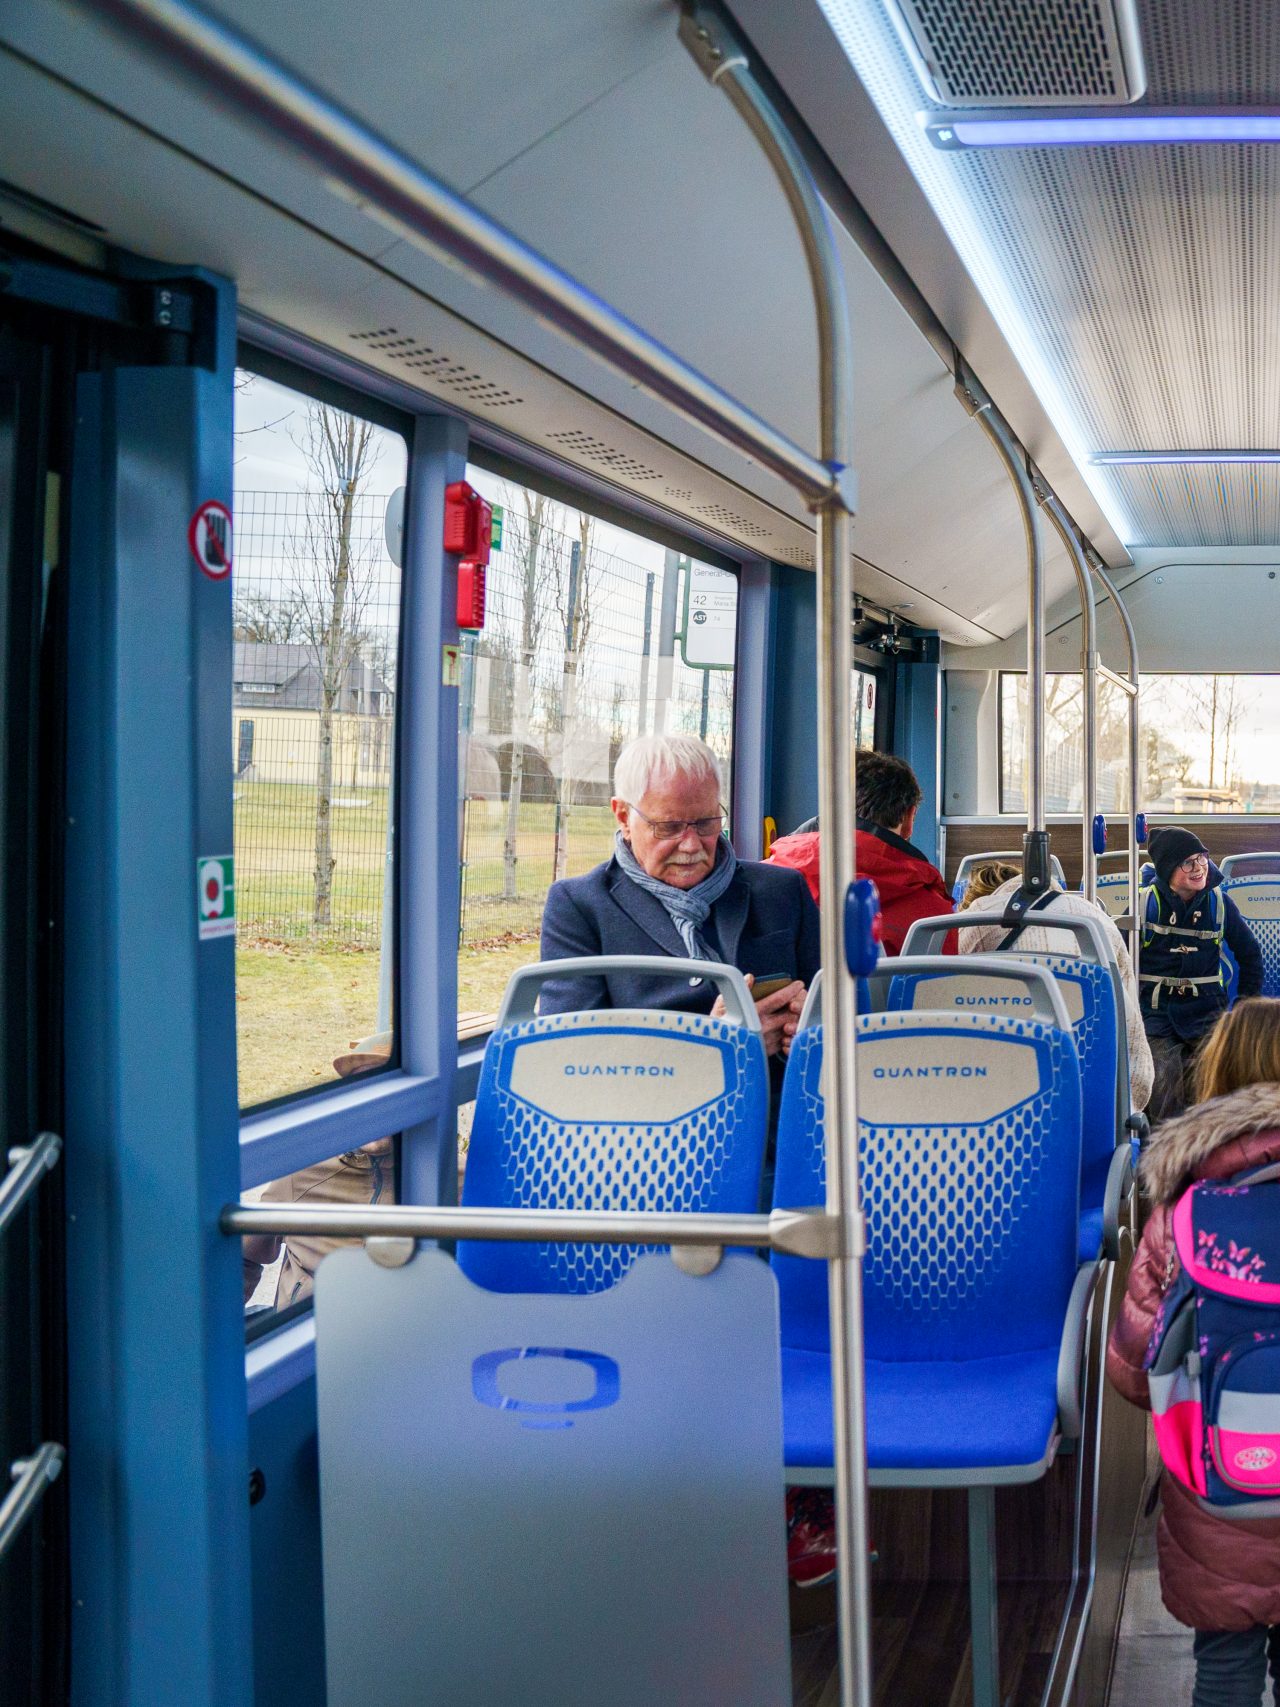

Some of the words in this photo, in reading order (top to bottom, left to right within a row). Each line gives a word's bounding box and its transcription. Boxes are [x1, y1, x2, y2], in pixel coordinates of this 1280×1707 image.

[693, 595, 707, 605] 42
[954, 996, 1033, 1006] QUANTRO
[564, 1064, 675, 1077] QUANTRON
[873, 1066, 987, 1078] QUANTRON
